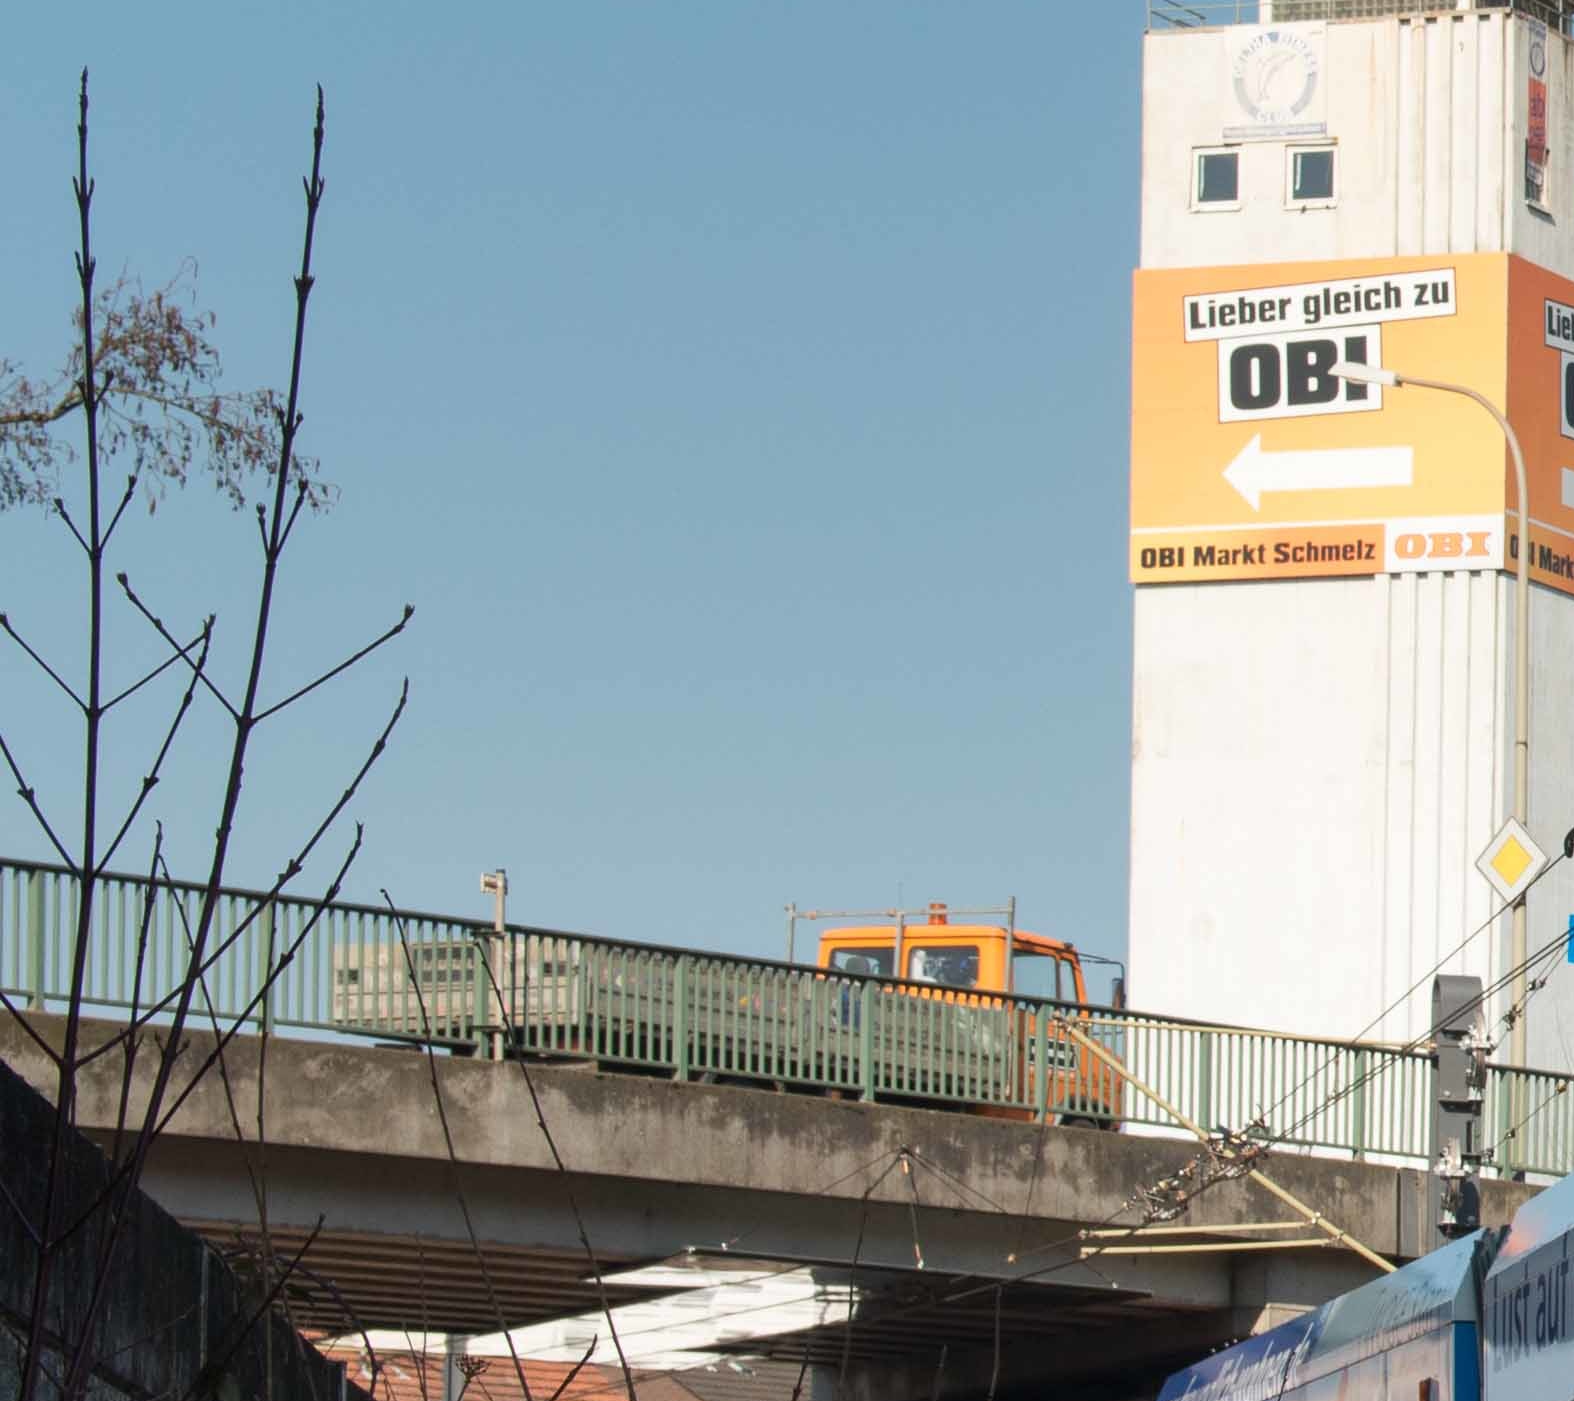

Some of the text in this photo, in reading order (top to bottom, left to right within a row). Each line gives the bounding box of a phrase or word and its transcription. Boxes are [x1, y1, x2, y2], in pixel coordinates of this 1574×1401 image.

[1189, 280, 1449, 330] Lieber gleich zu
[1229, 335, 1369, 411] OBI
[1140, 539, 1376, 569] OBI Markt Schmelz
[1394, 531, 1492, 560] OBI
[1510, 534, 1535, 566] OI
[1493, 1263, 1530, 1373] Lust
[1536, 1229, 1569, 1352] auf
